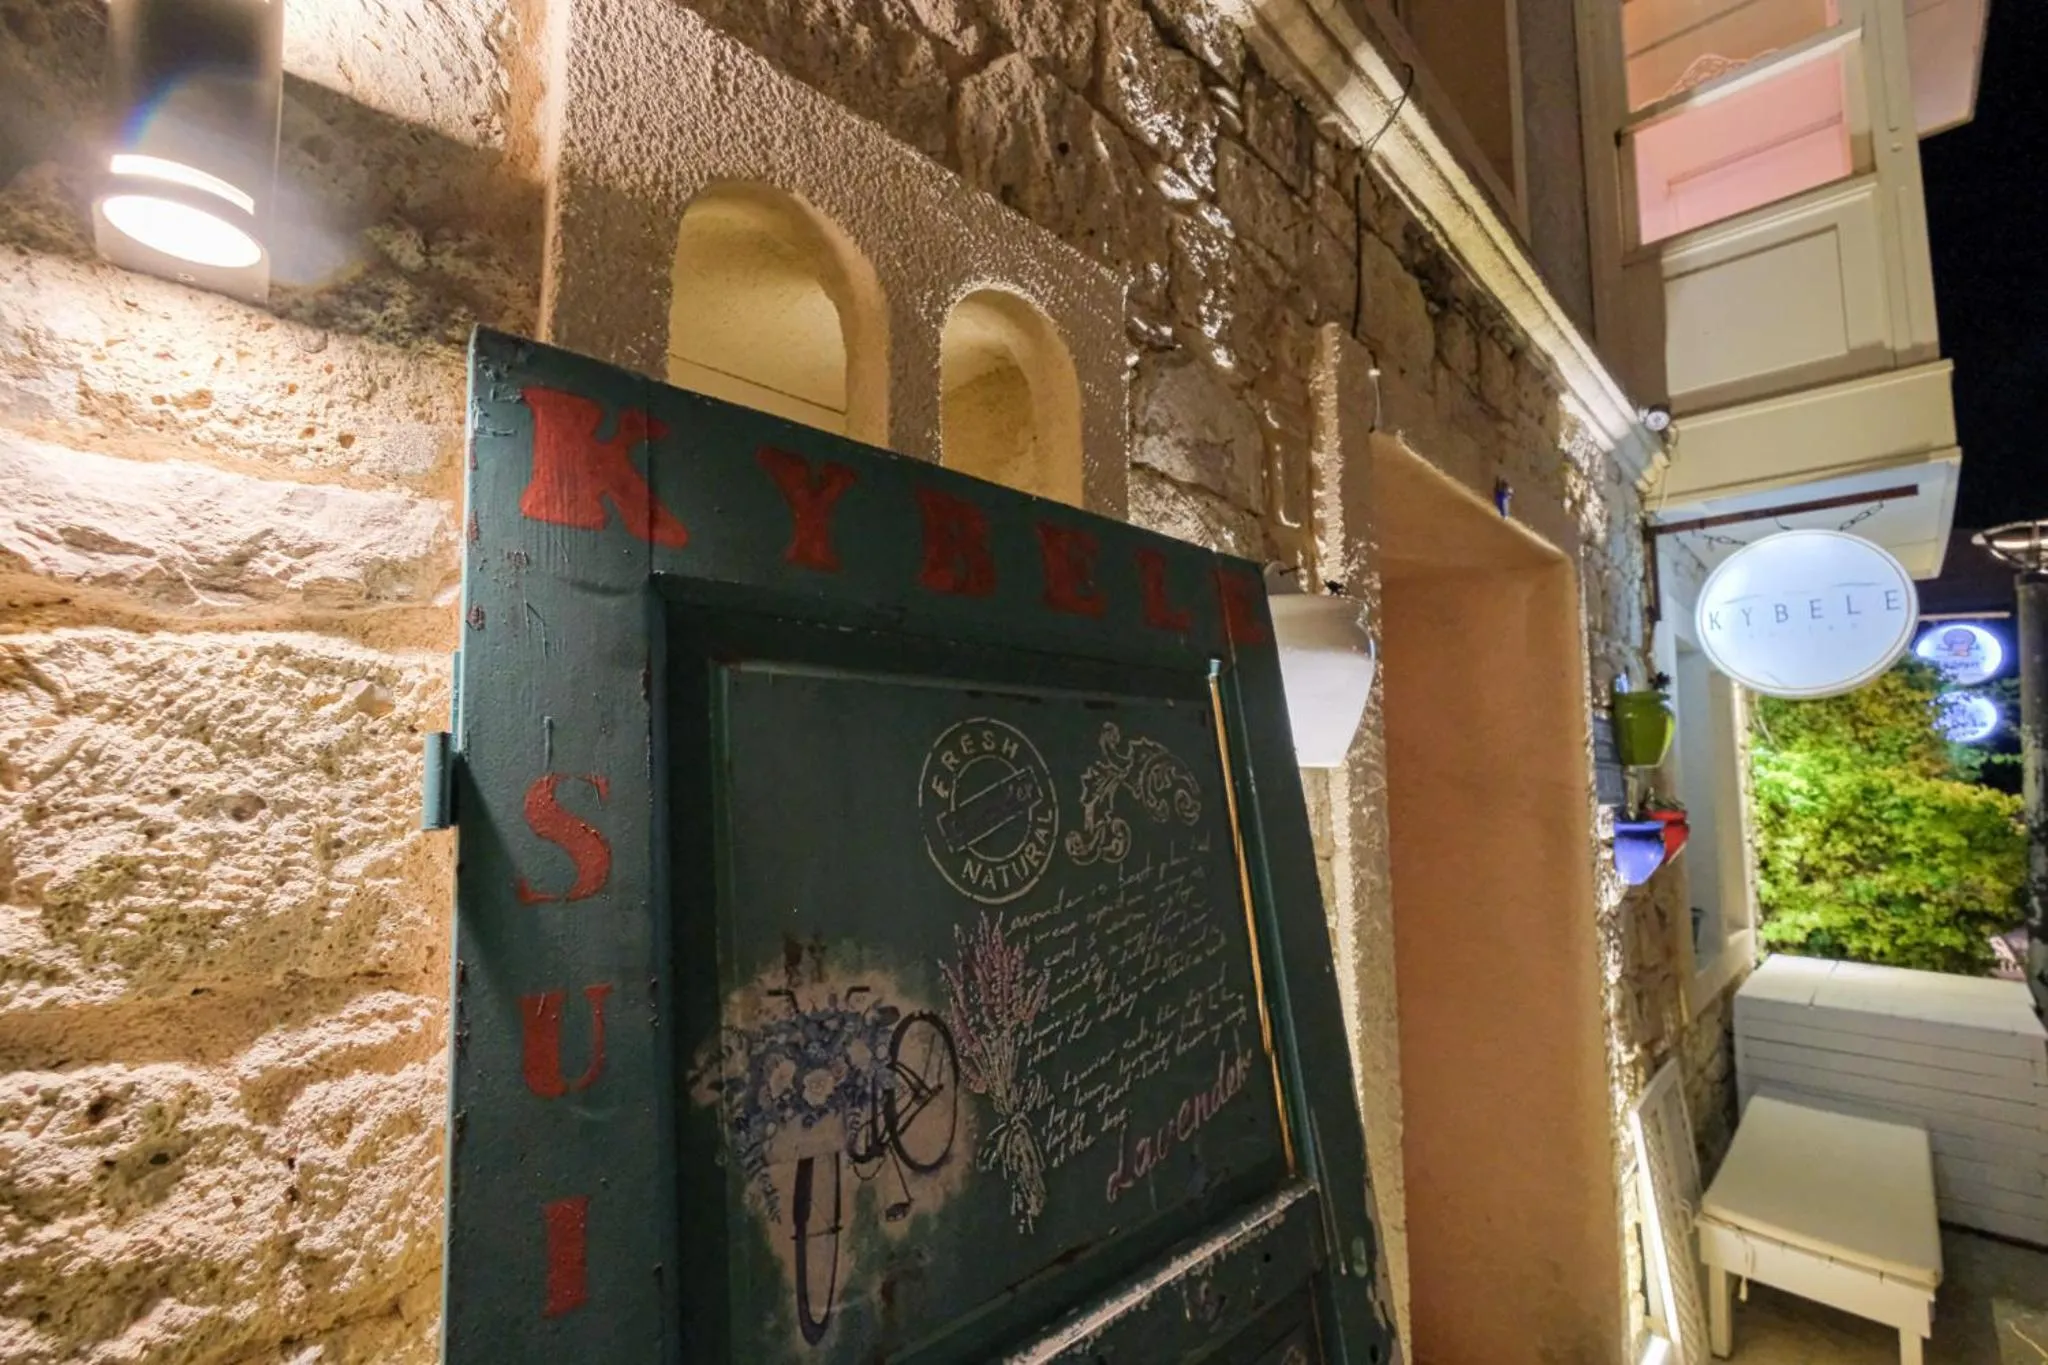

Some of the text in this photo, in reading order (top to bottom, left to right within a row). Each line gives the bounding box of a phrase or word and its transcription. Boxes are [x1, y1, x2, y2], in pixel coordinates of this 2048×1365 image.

[521, 386, 1267, 645] KYBELE
[1708, 590, 1901, 631] KYBELE
[931, 730, 1020, 799] FRESH
[961, 809, 1054, 891] NATURAL
[1106, 1049, 1252, 1203] Lavender
